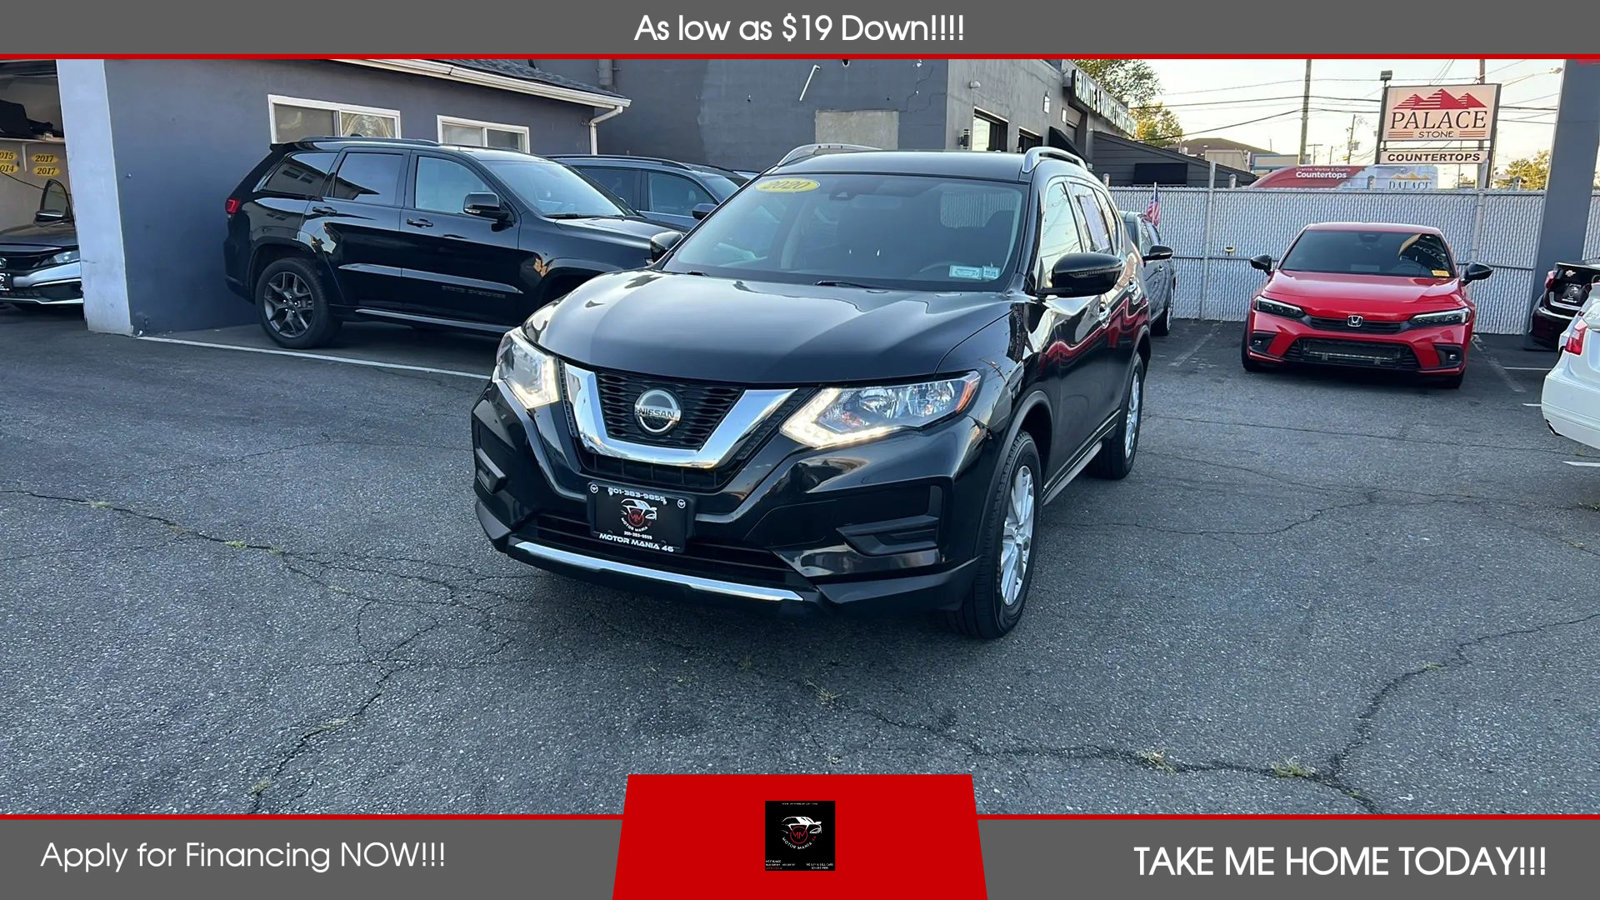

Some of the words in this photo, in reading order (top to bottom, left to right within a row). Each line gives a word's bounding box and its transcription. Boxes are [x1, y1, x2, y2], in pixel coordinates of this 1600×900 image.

[1390, 111, 1488, 130] PALACE
[1418, 130, 1454, 139] STONE
[0, 151, 14, 160] 015
[34, 154, 55, 163] 2017
[1387, 153, 1481, 162] COUNTERTOPS
[0, 164, 14, 173] 014
[36, 167, 56, 175] 2017
[1295, 171, 1347, 180] Countertops
[639, 408, 675, 418] NISSAN
[599, 533, 630, 544] MOTOR
[631, 539, 660, 550] MANIA
